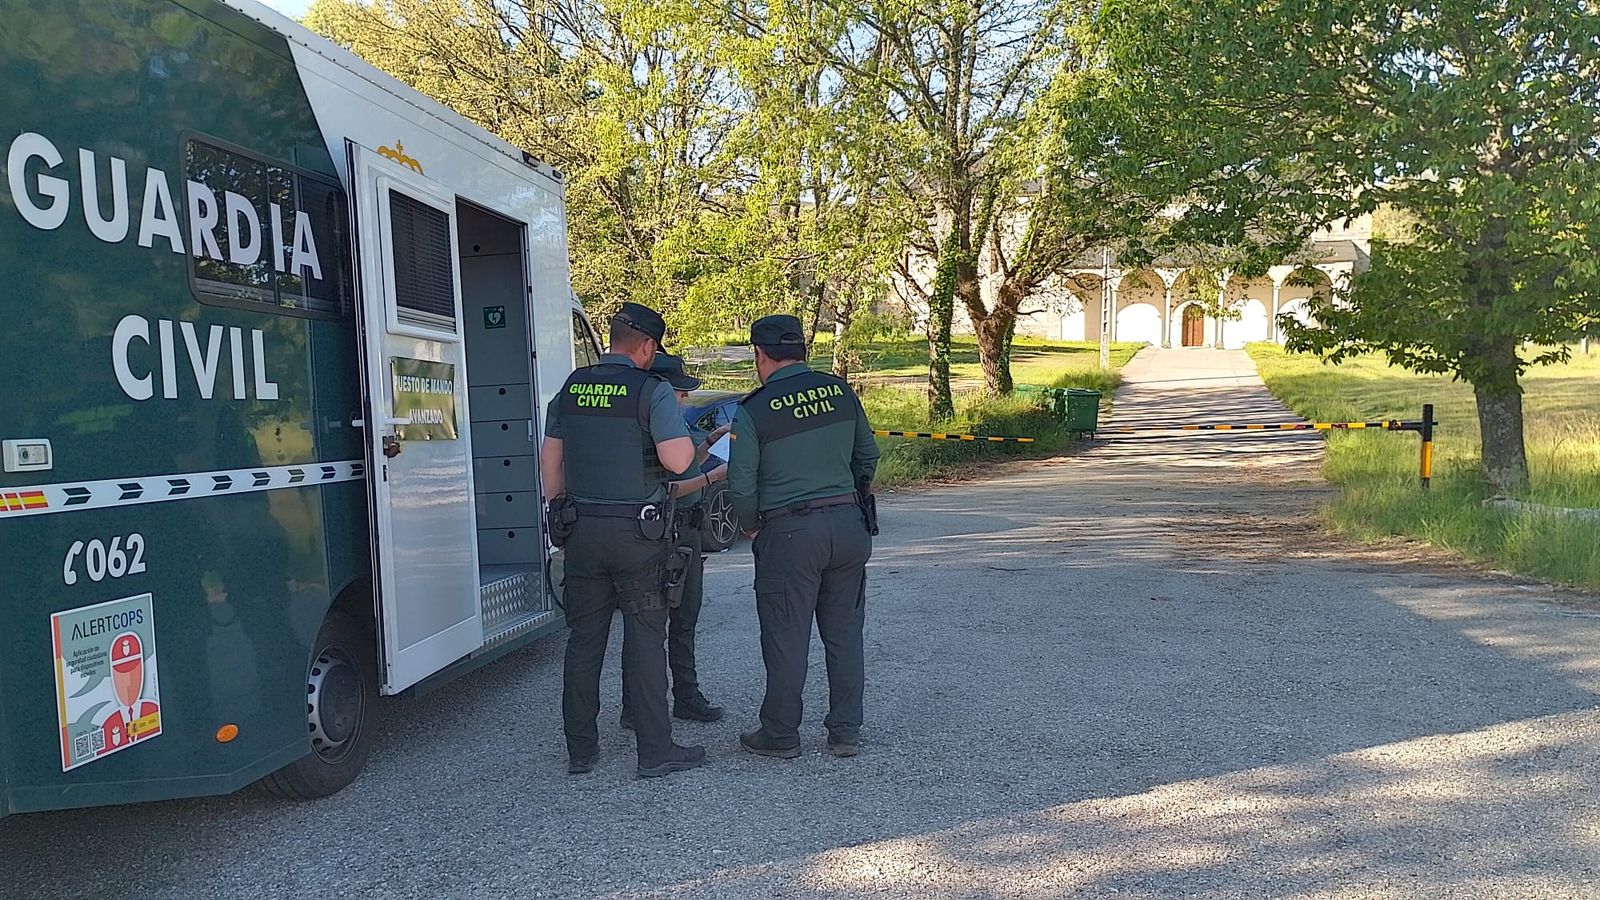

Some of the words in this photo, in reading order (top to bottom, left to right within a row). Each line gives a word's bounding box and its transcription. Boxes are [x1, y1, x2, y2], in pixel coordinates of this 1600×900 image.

[7, 132, 323, 281] GUARDIA
[112, 314, 279, 401] CIVIL
[394, 375, 420, 393] PUESTO
[421, 378, 430, 394] DE
[431, 379, 453, 395] MANDO
[569, 383, 627, 396] GUARDIA
[577, 394, 612, 408] CIVIL
[769, 384, 844, 411] GUARDIA
[409, 408, 443, 424] AVANZADO
[793, 400, 835, 419] CIVIL
[86, 533, 146, 582] 062
[71, 608, 143, 641] ALERTCOPS
